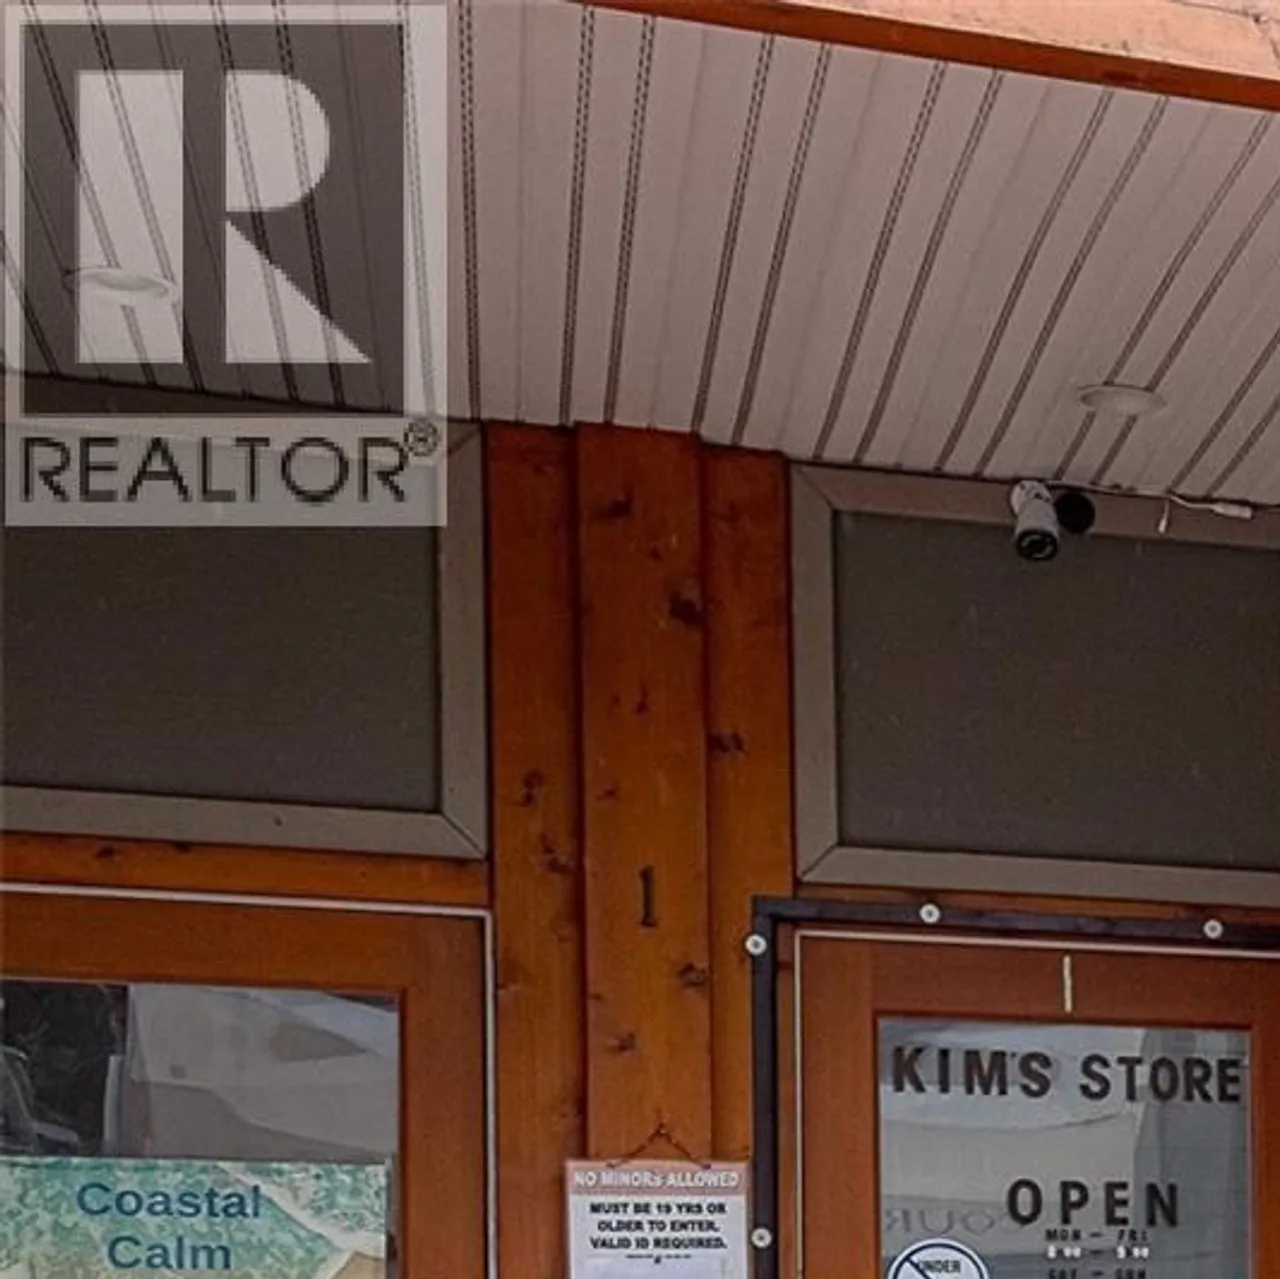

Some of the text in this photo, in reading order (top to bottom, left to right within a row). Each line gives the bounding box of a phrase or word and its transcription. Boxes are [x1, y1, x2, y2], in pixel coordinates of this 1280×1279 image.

[1079, 1053, 1243, 1104] STORE
[574, 1171, 598, 1188] NO
[666, 1171, 740, 1188] ALLOWED
[76, 1182, 261, 1219] Coastal
[589, 1203, 630, 1214] MUST
[633, 1203, 651, 1214] BE
[676, 1203, 704, 1214] YRS
[706, 1203, 727, 1214] OR
[1007, 1178, 1179, 1228] OPEN
[597, 1219, 644, 1232] OLDER
[649, 1220, 667, 1232] TO
[107, 1235, 232, 1270] Calm
[590, 1237, 632, 1249] VALID
[635, 1237, 651, 1249] ID
